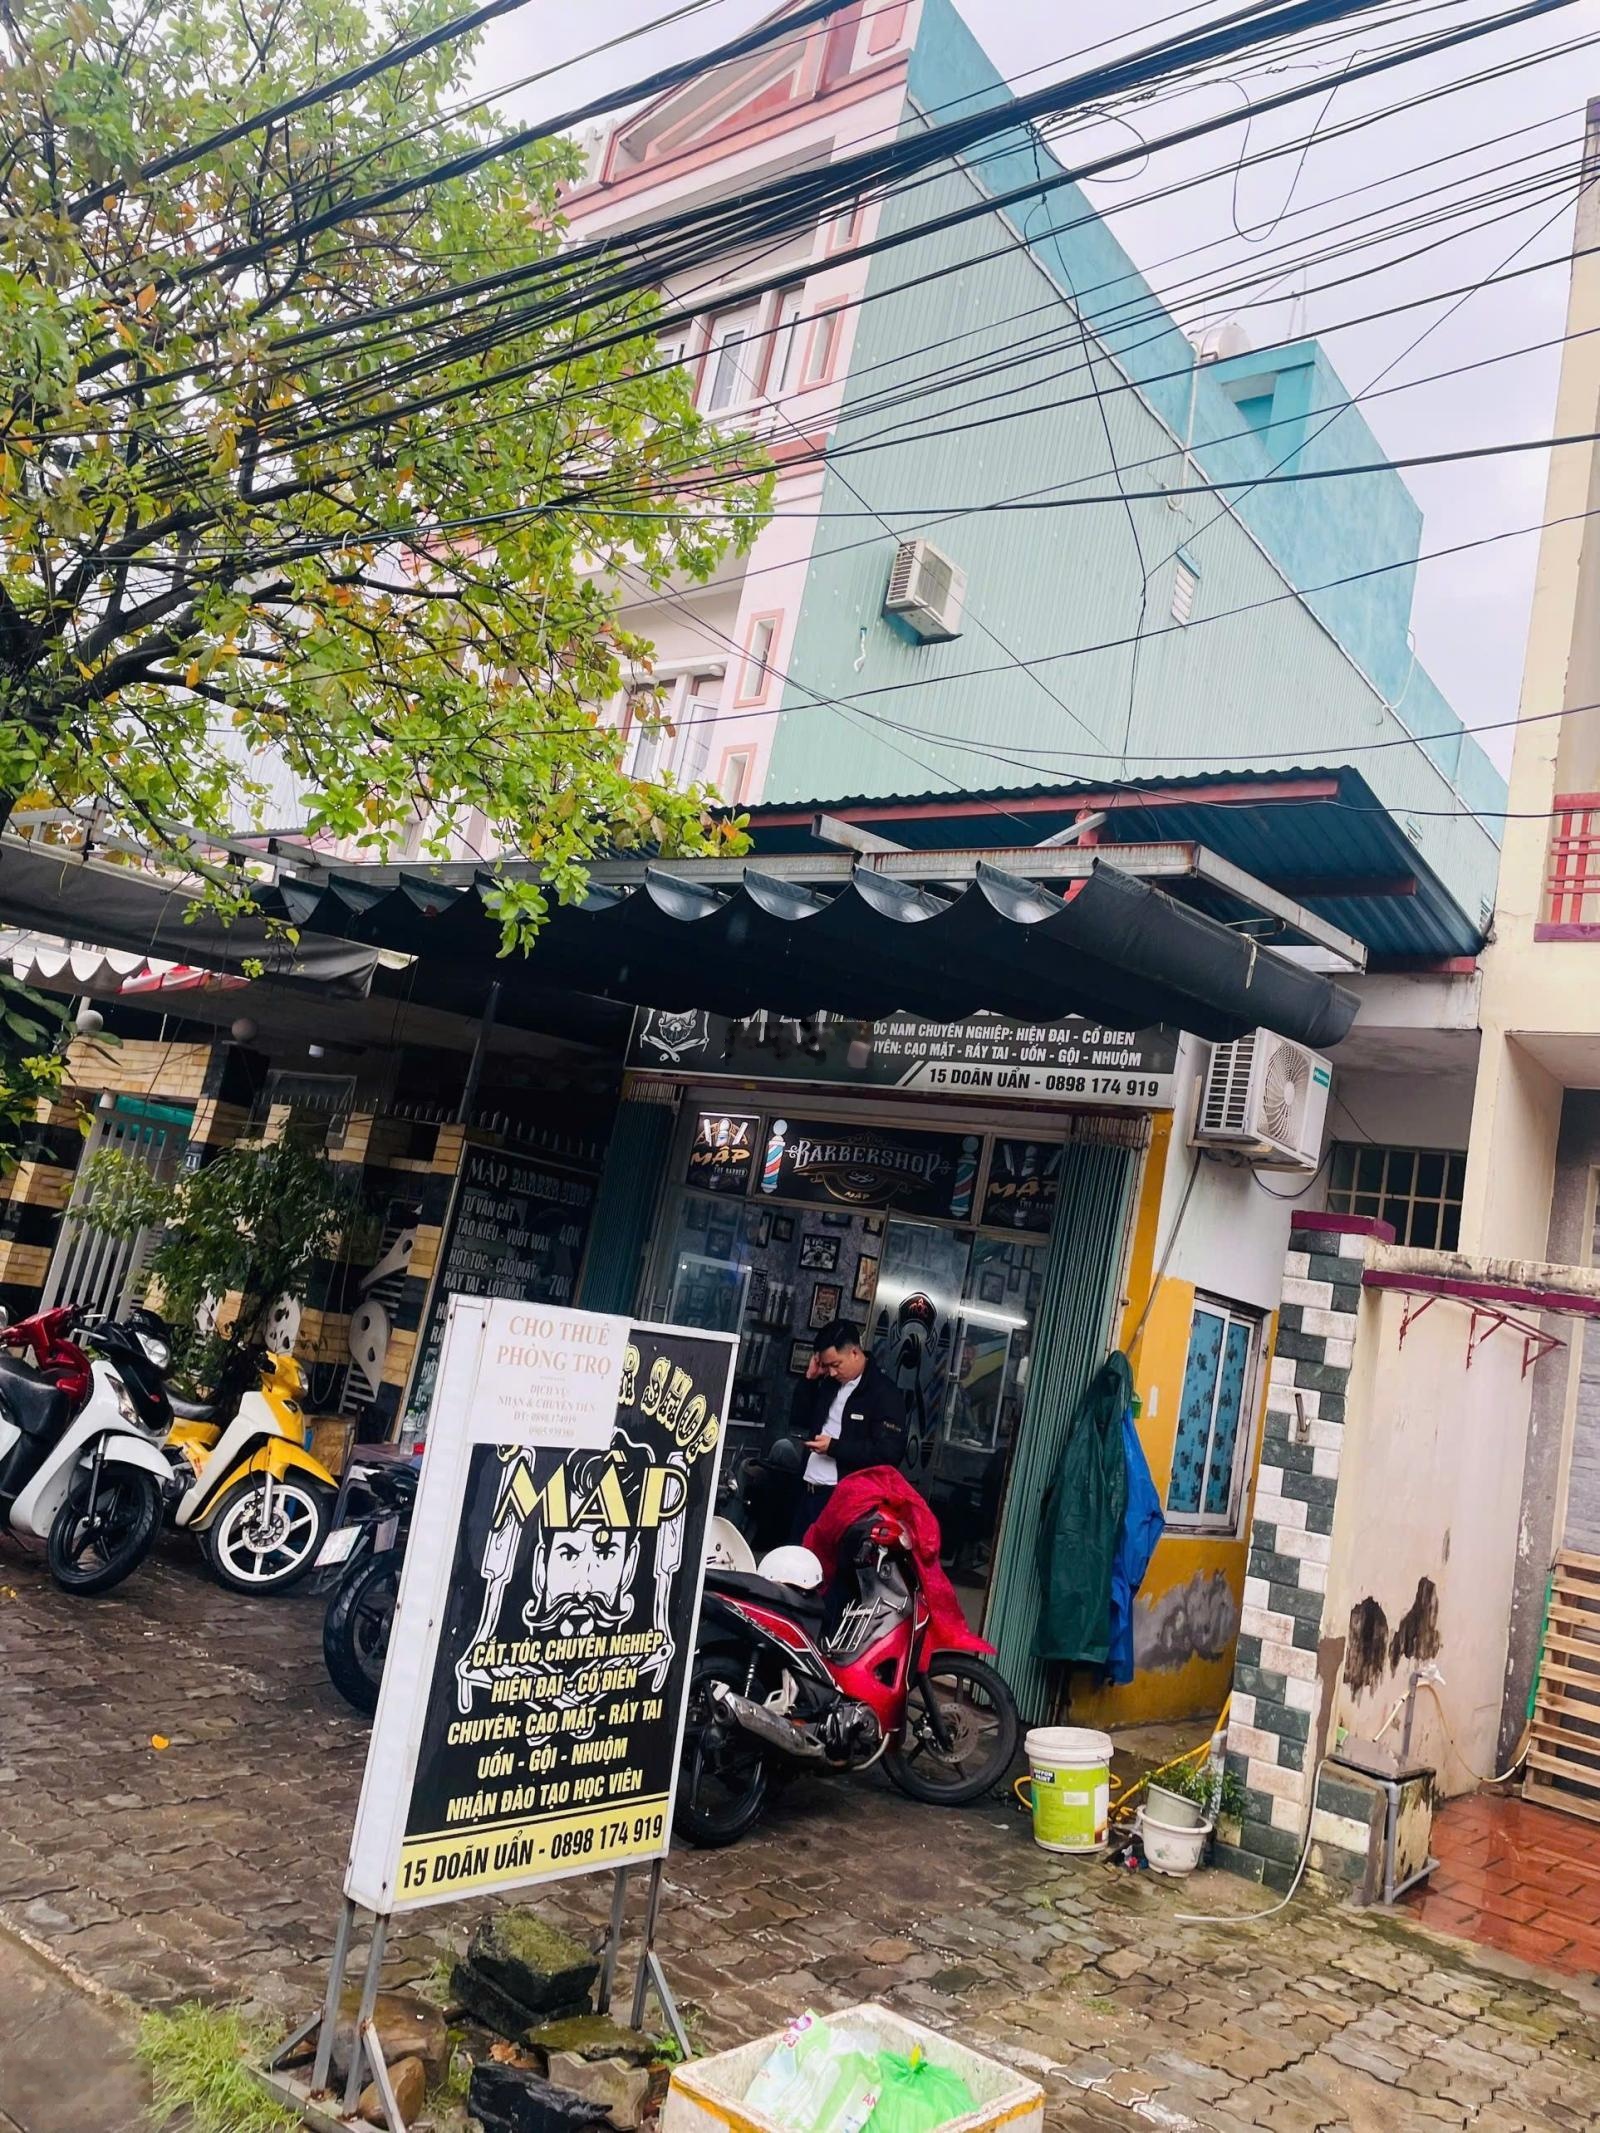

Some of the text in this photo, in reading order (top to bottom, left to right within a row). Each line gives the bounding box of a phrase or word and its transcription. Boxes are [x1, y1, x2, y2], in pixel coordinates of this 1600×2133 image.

[873, 1020, 887, 1035] ÓC
[890, 1022, 916, 1036] NAM
[918, 1022, 964, 1038] CHUYÊN
[966, 1024, 1013, 1042] NGHIỆP:
[1016, 1025, 1046, 1044] HIỆN
[1048, 1029, 1070, 1045] ĐẠI
[873, 1039, 902, 1054] YÊN:
[904, 1042, 926, 1058] CẠO
[929, 1041, 955, 1060] MẶT
[964, 1043, 989, 1059] RÁY
[991, 1047, 1009, 1060] TAI
[1020, 1043, 1047, 1062] UỐN
[1058, 1047, 1080, 1066] GỘI
[1092, 1049, 1142, 1069] NHUỘM
[930, 1068, 946, 1083] 15
[950, 1068, 995, 1087] DOÃN
[997, 1065, 1030, 1089] UẨN
[1045, 1075, 1085, 1092] 0898
[1091, 1077, 1121, 1095] 174
[1127, 1078, 1159, 1097] 919
[185, 1155, 197, 1168] 11
[789, 1140, 941, 1183] BARBERSHOP
[530, 1232, 551, 1251] WAX
[549, 1274, 572, 1298] 70K
[508, 1315, 610, 1346] CHO THUÊ
[496, 1343, 567, 1371] PHÒNG
[573, 1352, 612, 1380] TRỌ
[641, 1356, 720, 1464] SHOP
[493, 1449, 689, 1546] MẬP
[472, 1629, 664, 1668] CẮT TÓC CHUYÊN NGHIỆP
[491, 1673, 532, 1706] HIỆN
[535, 1675, 564, 1702] ĐẠI
[577, 1663, 601, 1694] CỔ
[602, 1660, 639, 1692] ĐIỂN
[447, 1713, 522, 1745] CHUYÊN:
[561, 1703, 597, 1734] MẶT
[608, 1698, 639, 1725] RÁY
[477, 1746, 514, 1779] UỐN
[529, 1744, 558, 1775] GỘI
[571, 1735, 628, 1766] NHUỘM
[446, 1769, 643, 1822] NHẬN ĐÀO TẠO HỌC VIÊN
[403, 1859, 427, 1889] 15
[432, 1844, 489, 1884] DOÃN
[494, 1830, 534, 1870] UẨN
[551, 1828, 594, 1859] 0898
[599, 1821, 628, 1850] 174
[633, 1814, 663, 1842] 919
